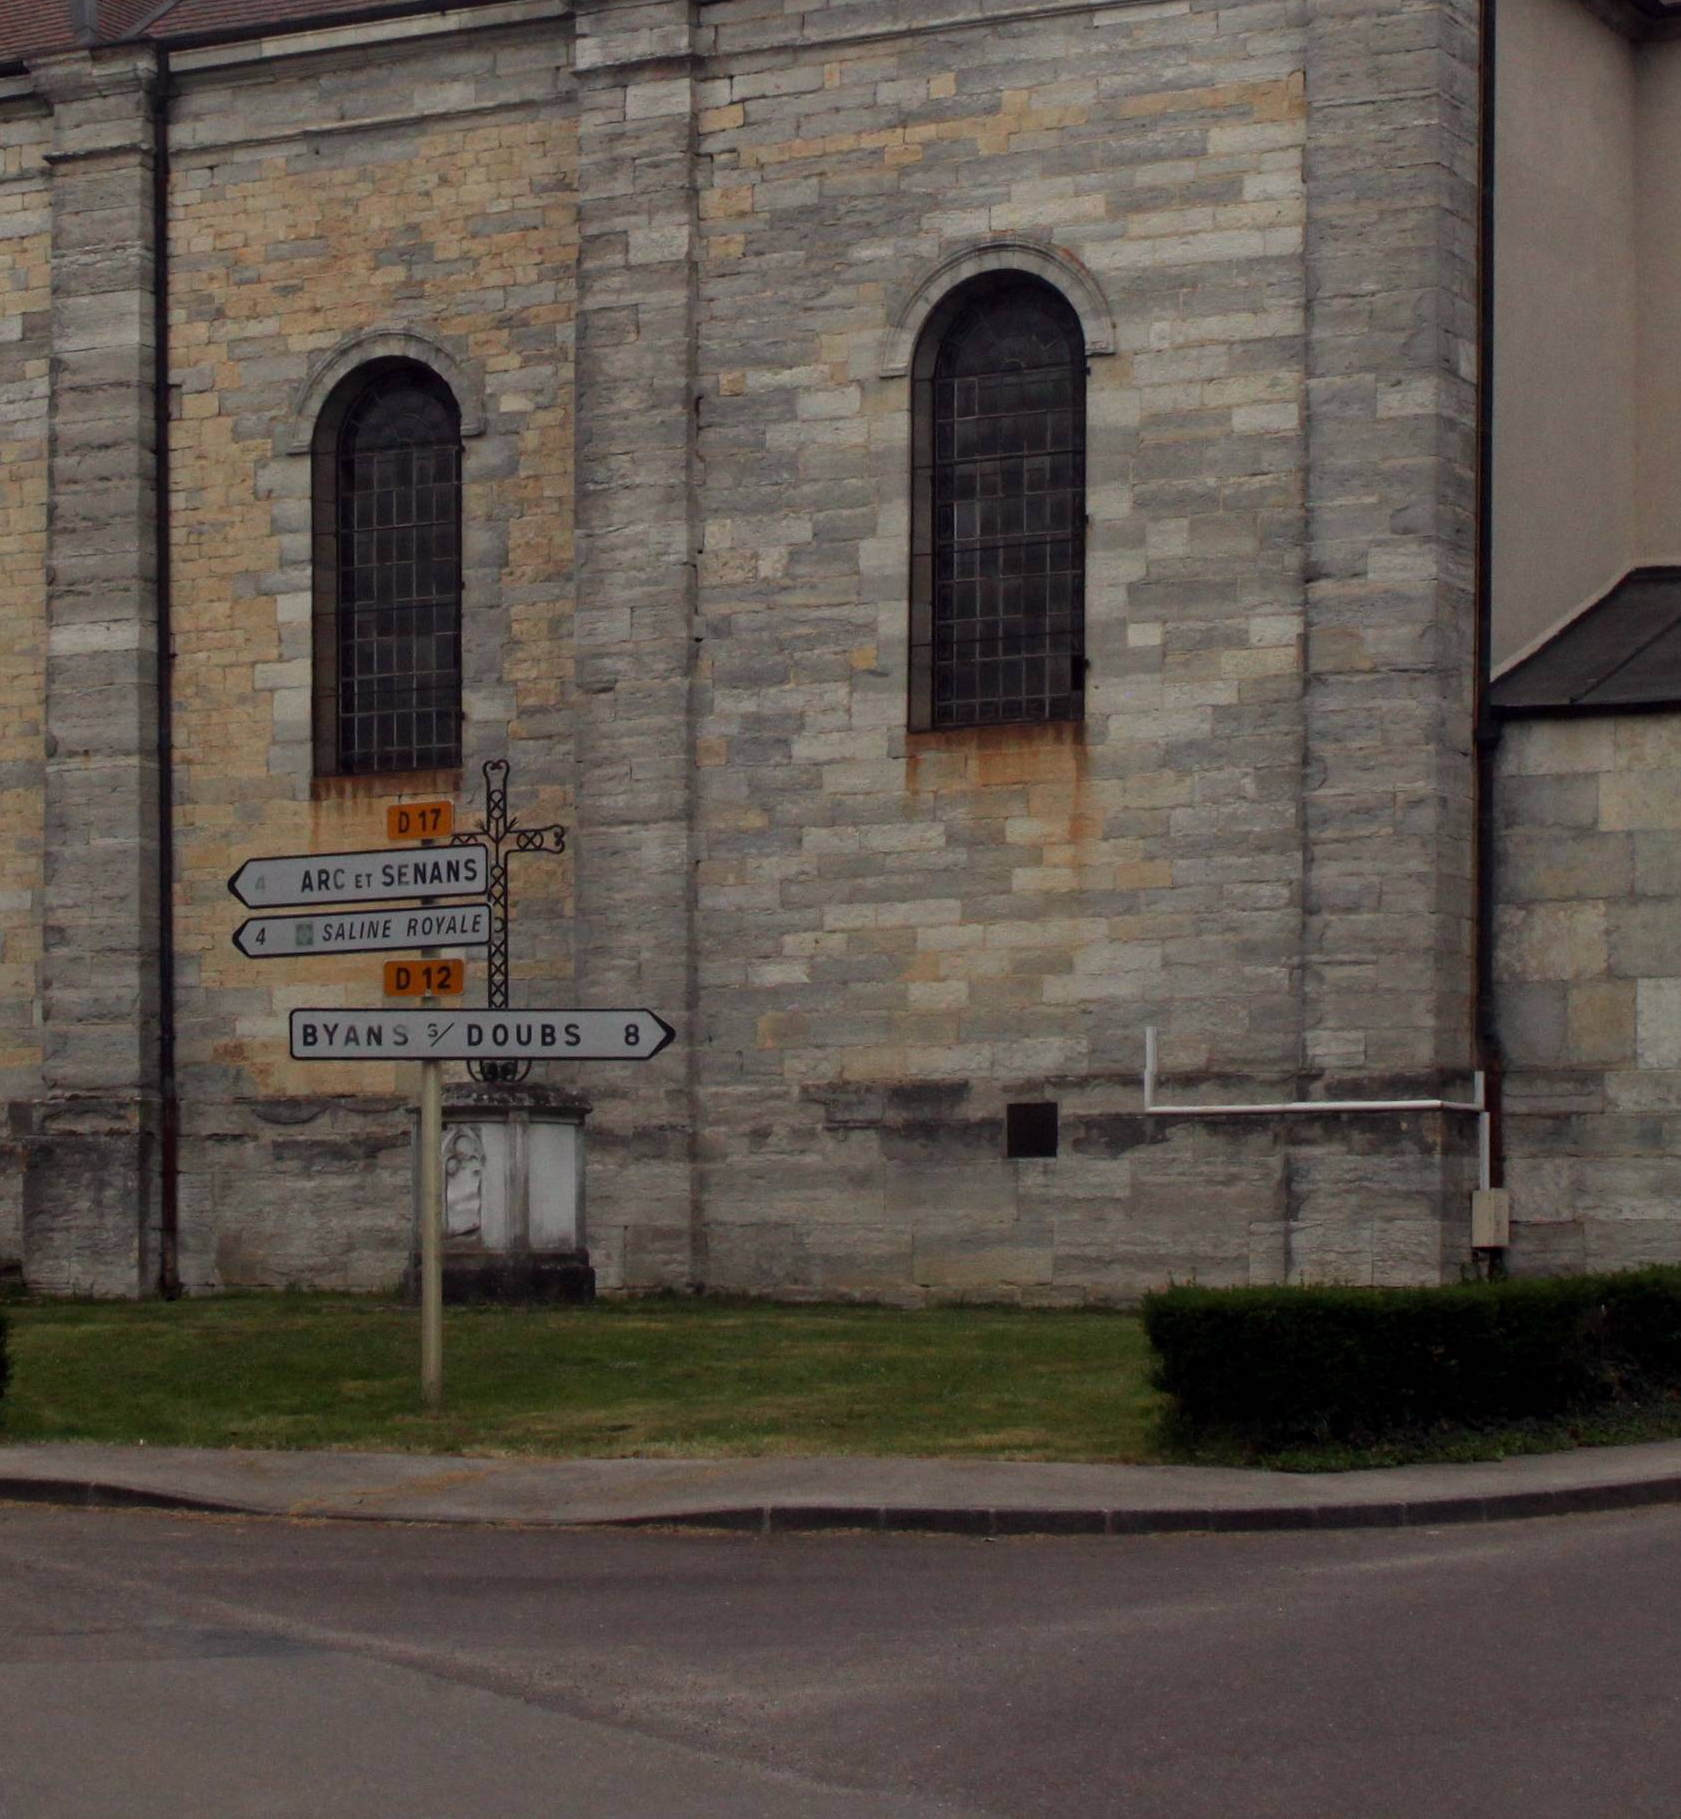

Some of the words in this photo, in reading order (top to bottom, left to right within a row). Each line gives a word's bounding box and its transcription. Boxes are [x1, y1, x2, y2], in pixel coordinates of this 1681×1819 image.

[397, 811, 410, 834] D
[418, 808, 442, 832] 17
[300, 868, 345, 893] ARC
[355, 874, 373, 889] ET
[381, 859, 478, 887] SENANS
[255, 927, 267, 946] 4
[322, 919, 392, 942] SALINE
[406, 913, 482, 937] ROYALE
[396, 967, 412, 991] D
[421, 965, 452, 990] 12
[302, 1023, 409, 1047] BYANS
[466, 1023, 582, 1047] DOUBS
[623, 1023, 641, 1047] 8
